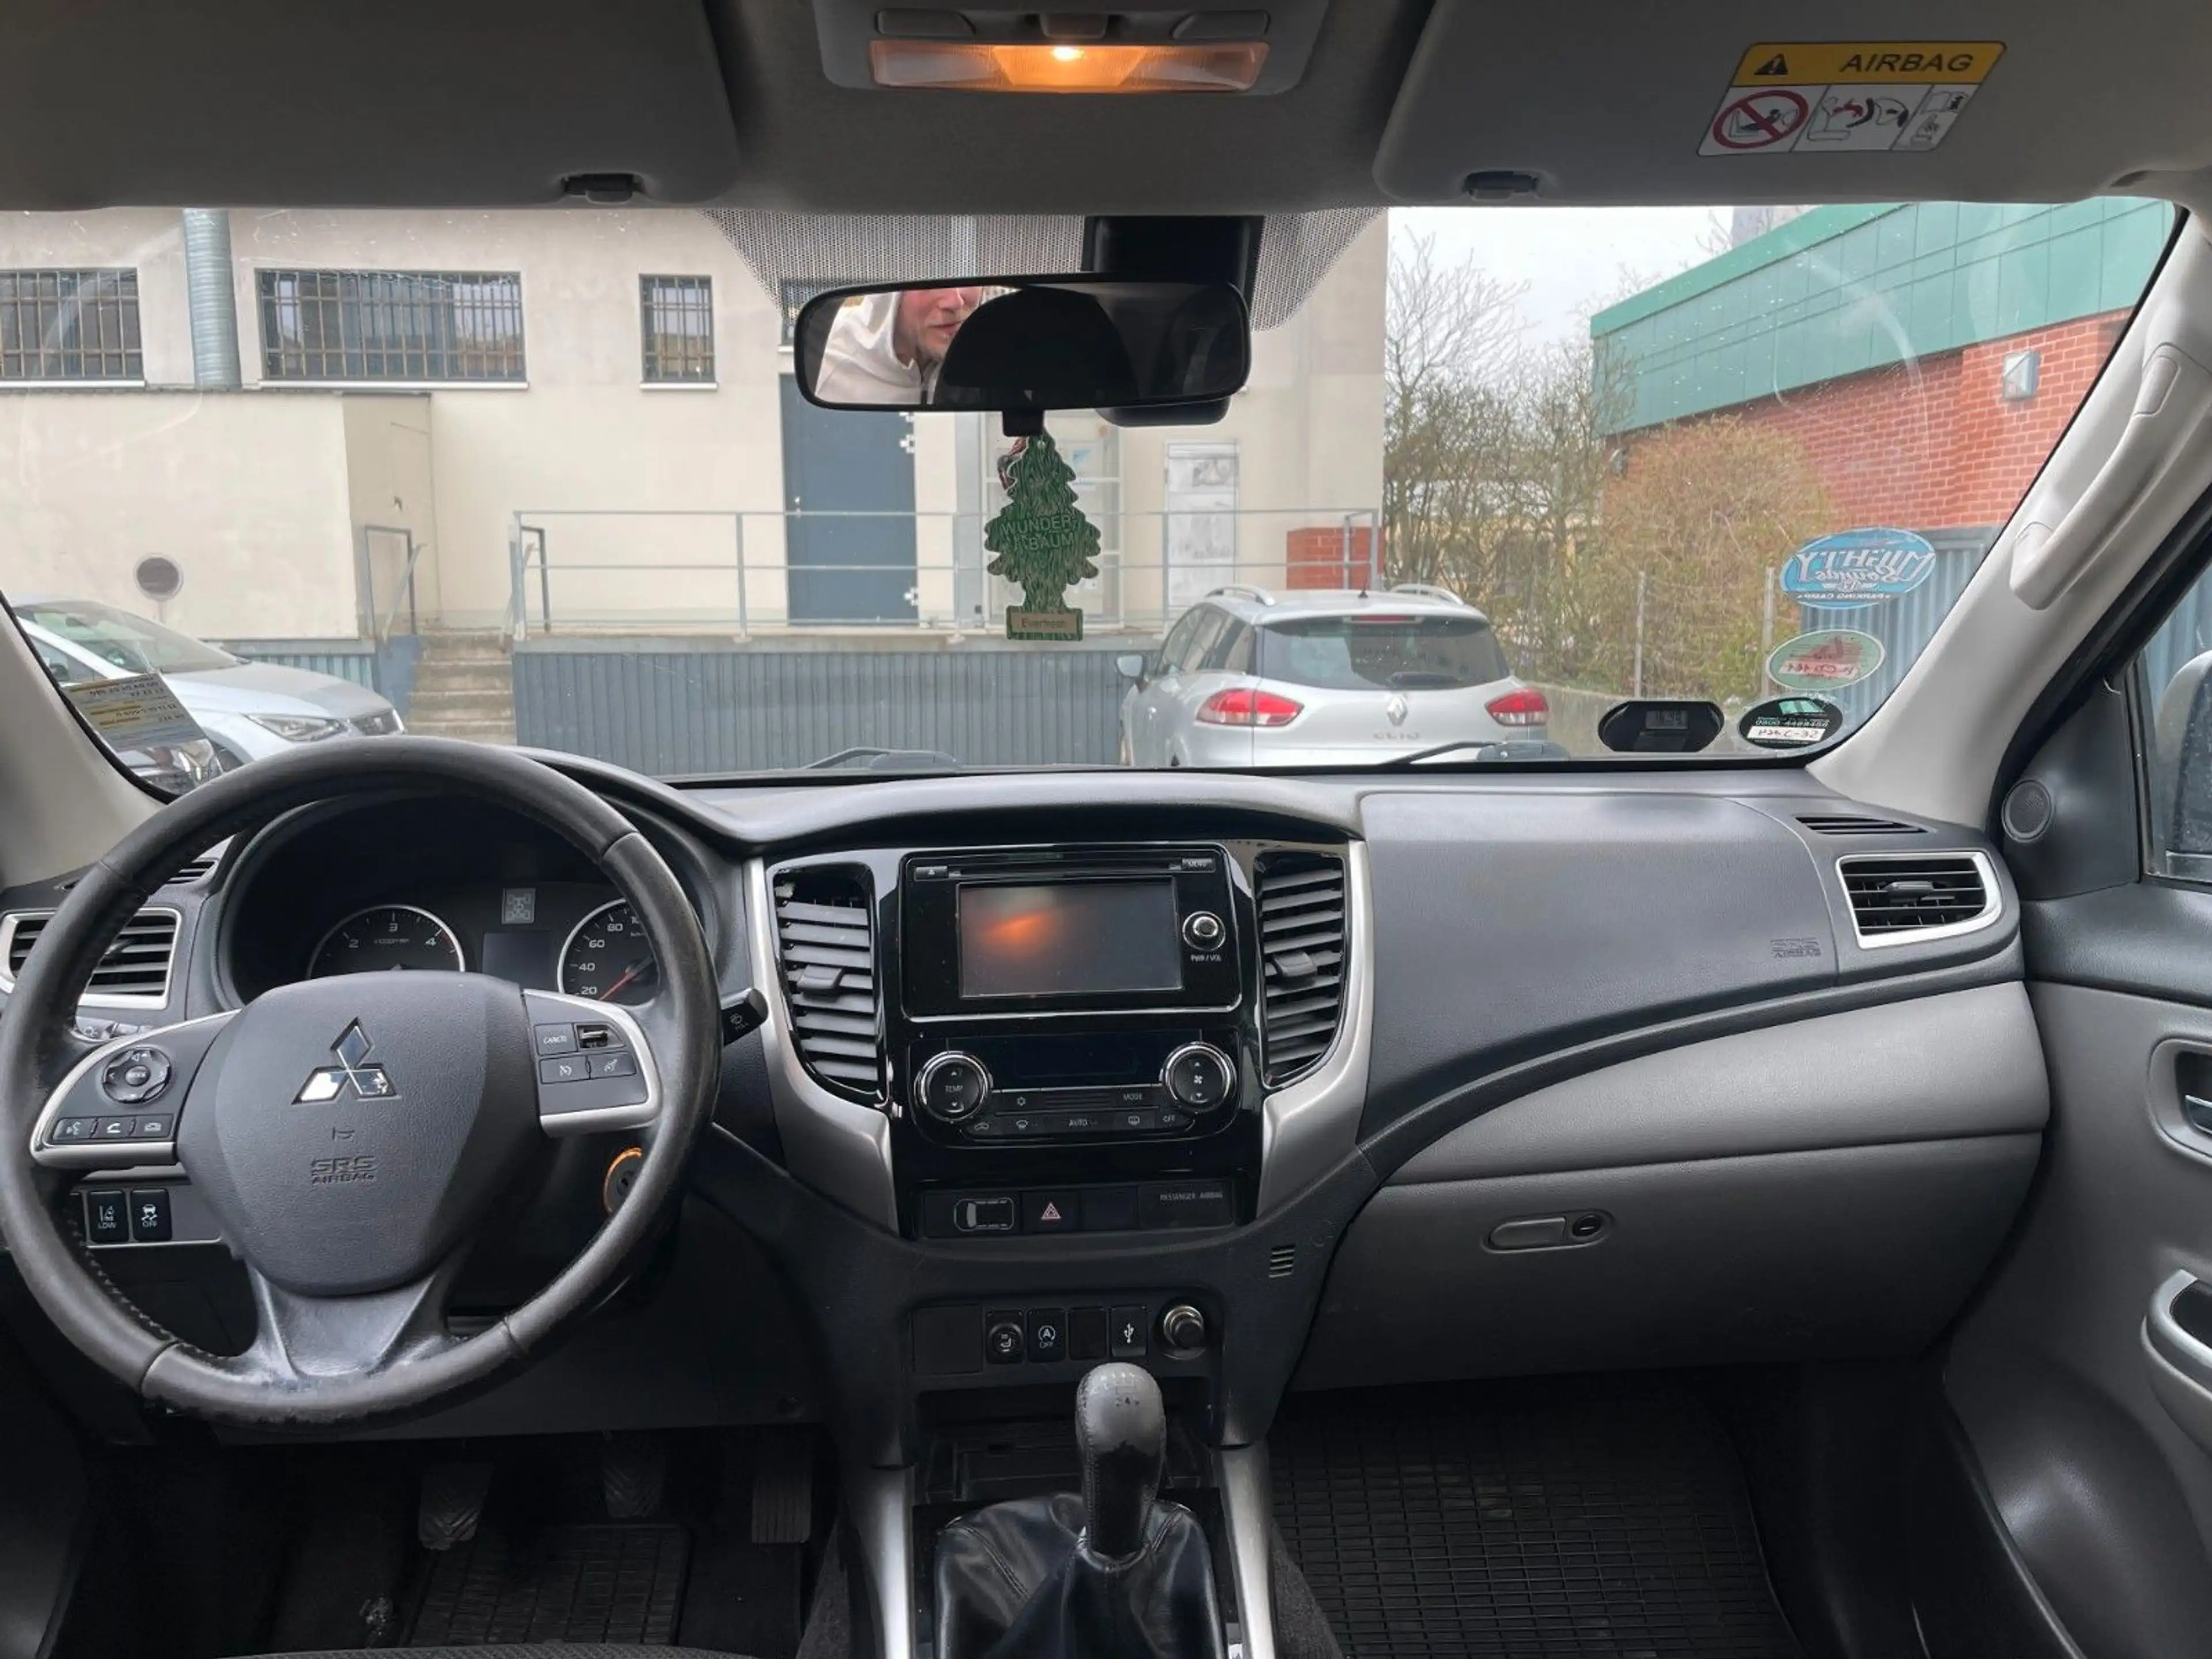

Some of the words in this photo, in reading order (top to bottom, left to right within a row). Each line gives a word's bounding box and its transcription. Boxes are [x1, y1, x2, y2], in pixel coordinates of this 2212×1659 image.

[1839, 53, 1974, 73] AIRBAG
[1000, 514, 1073, 536] WUNDER
[1029, 532, 1074, 551] BAUM
[1373, 731, 1420, 741] CLIO
[388, 922, 398, 933] 3
[607, 923, 624, 931] 80
[349, 938, 359, 949] 2
[425, 937, 437, 947] 4
[589, 940, 605, 949] 60
[579, 962, 596, 972] 40
[581, 986, 598, 995] 20
[543, 1035, 567, 1044] CANCEL
[1123, 1093, 1143, 1101] MODE
[1068, 1118, 1088, 1127] AUTO
[310, 1155, 378, 1173] SRS
[142, 1220, 158, 1228] OFF
